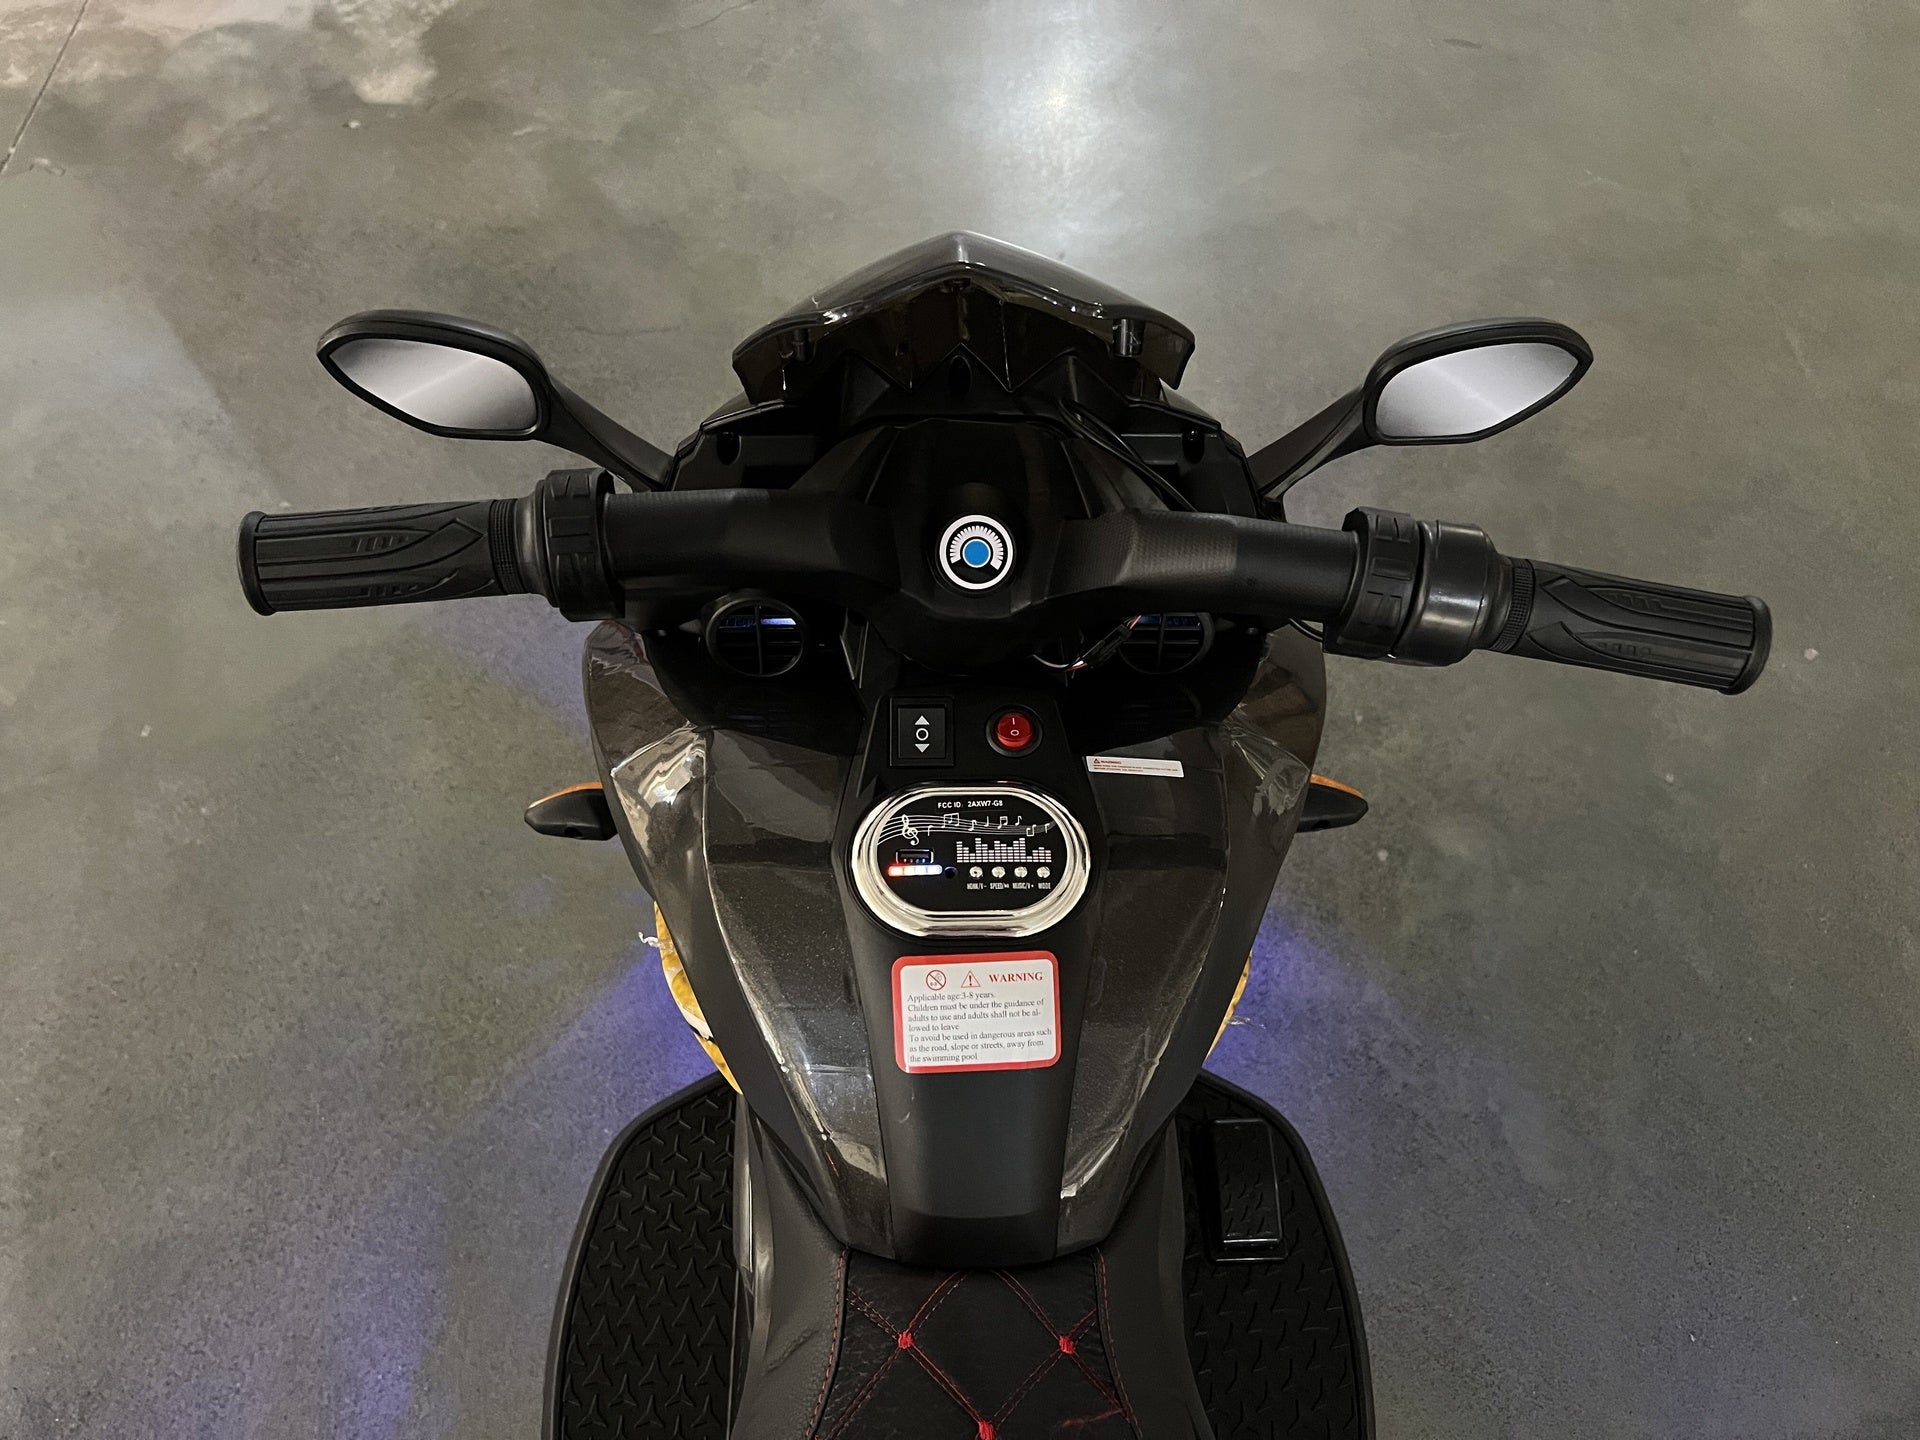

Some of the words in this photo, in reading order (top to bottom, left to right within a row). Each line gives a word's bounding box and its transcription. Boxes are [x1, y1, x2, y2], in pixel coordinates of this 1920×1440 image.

[988, 971, 1043, 983] WARNING
[907, 993, 946, 1003] Applicable
[907, 1003, 939, 1012] Children
[958, 1002, 967, 1010] be
[969, 1001, 990, 1009] under
[991, 1000, 1003, 1008] the
[1003, 999, 1035, 1009] guidance
[1036, 998, 1044, 1006] of
[907, 1013, 929, 1022] adults
[952, 1012, 967, 1020] and
[967, 1011, 989, 1019] adults
[990, 1010, 1007, 1018] shall
[1031, 1008, 1041, 1016] al-
[908, 1023, 930, 1032] lowed
[940, 1023, 959, 1031] leave
[909, 1034, 920, 1042] To
[920, 1033, 941, 1042] avoid
[941, 1033, 951, 1041] be
[952, 1032, 969, 1040] used
[979, 1031, 1016, 1040] dangerous
[1036, 1028, 1052, 1036] such
[918, 1044, 930, 1052] the
[931, 1043, 950, 1052] road,
[950, 1042, 970, 1052] slope
[1006, 1040, 1026, 1049] away
[1027, 1039, 1044, 1047] from
[922, 1053, 960, 1063] swimming
[961, 1052, 978, 1062] pool
